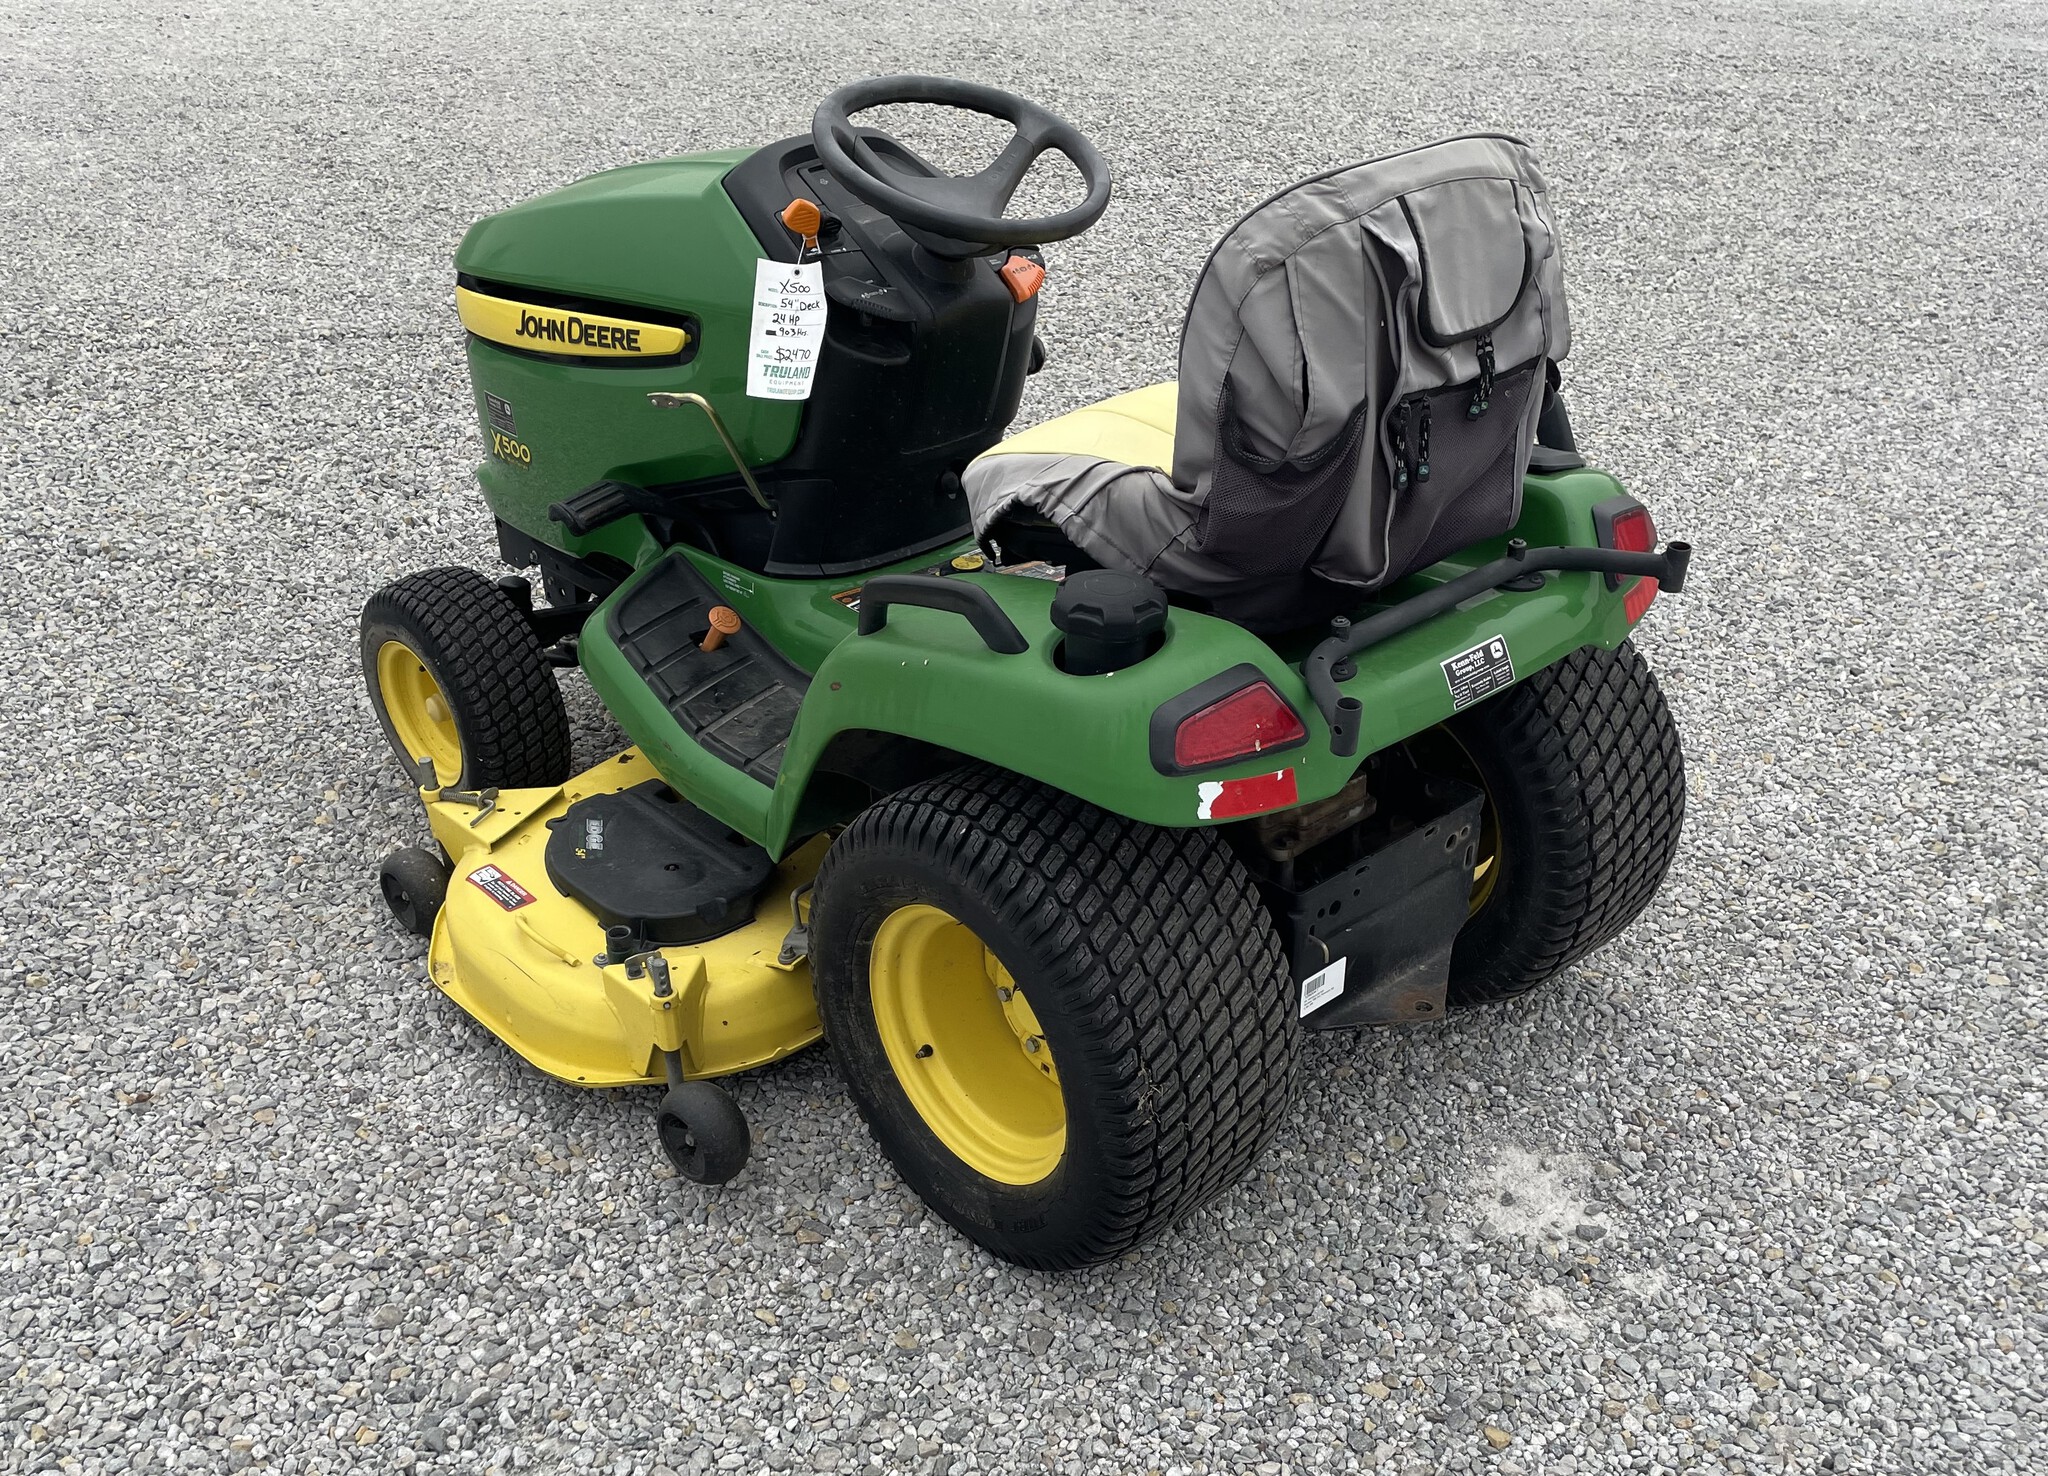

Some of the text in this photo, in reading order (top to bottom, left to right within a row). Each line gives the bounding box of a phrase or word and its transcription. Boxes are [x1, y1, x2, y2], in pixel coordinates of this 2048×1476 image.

[780, 279, 810, 294] X500
[800, 300, 820, 311] Deck
[772, 313, 786, 324] 24
[515, 309, 641, 352] JOHN DEERE
[779, 326, 796, 337] 903
[774, 345, 811, 363] $2470
[763, 364, 811, 379] TRULAND
[489, 427, 531, 463] X500
[1450, 649, 1485, 671] Kenn-Feld
[1474, 657, 1486, 668] LLC
[586, 818, 603, 850] EDGE
